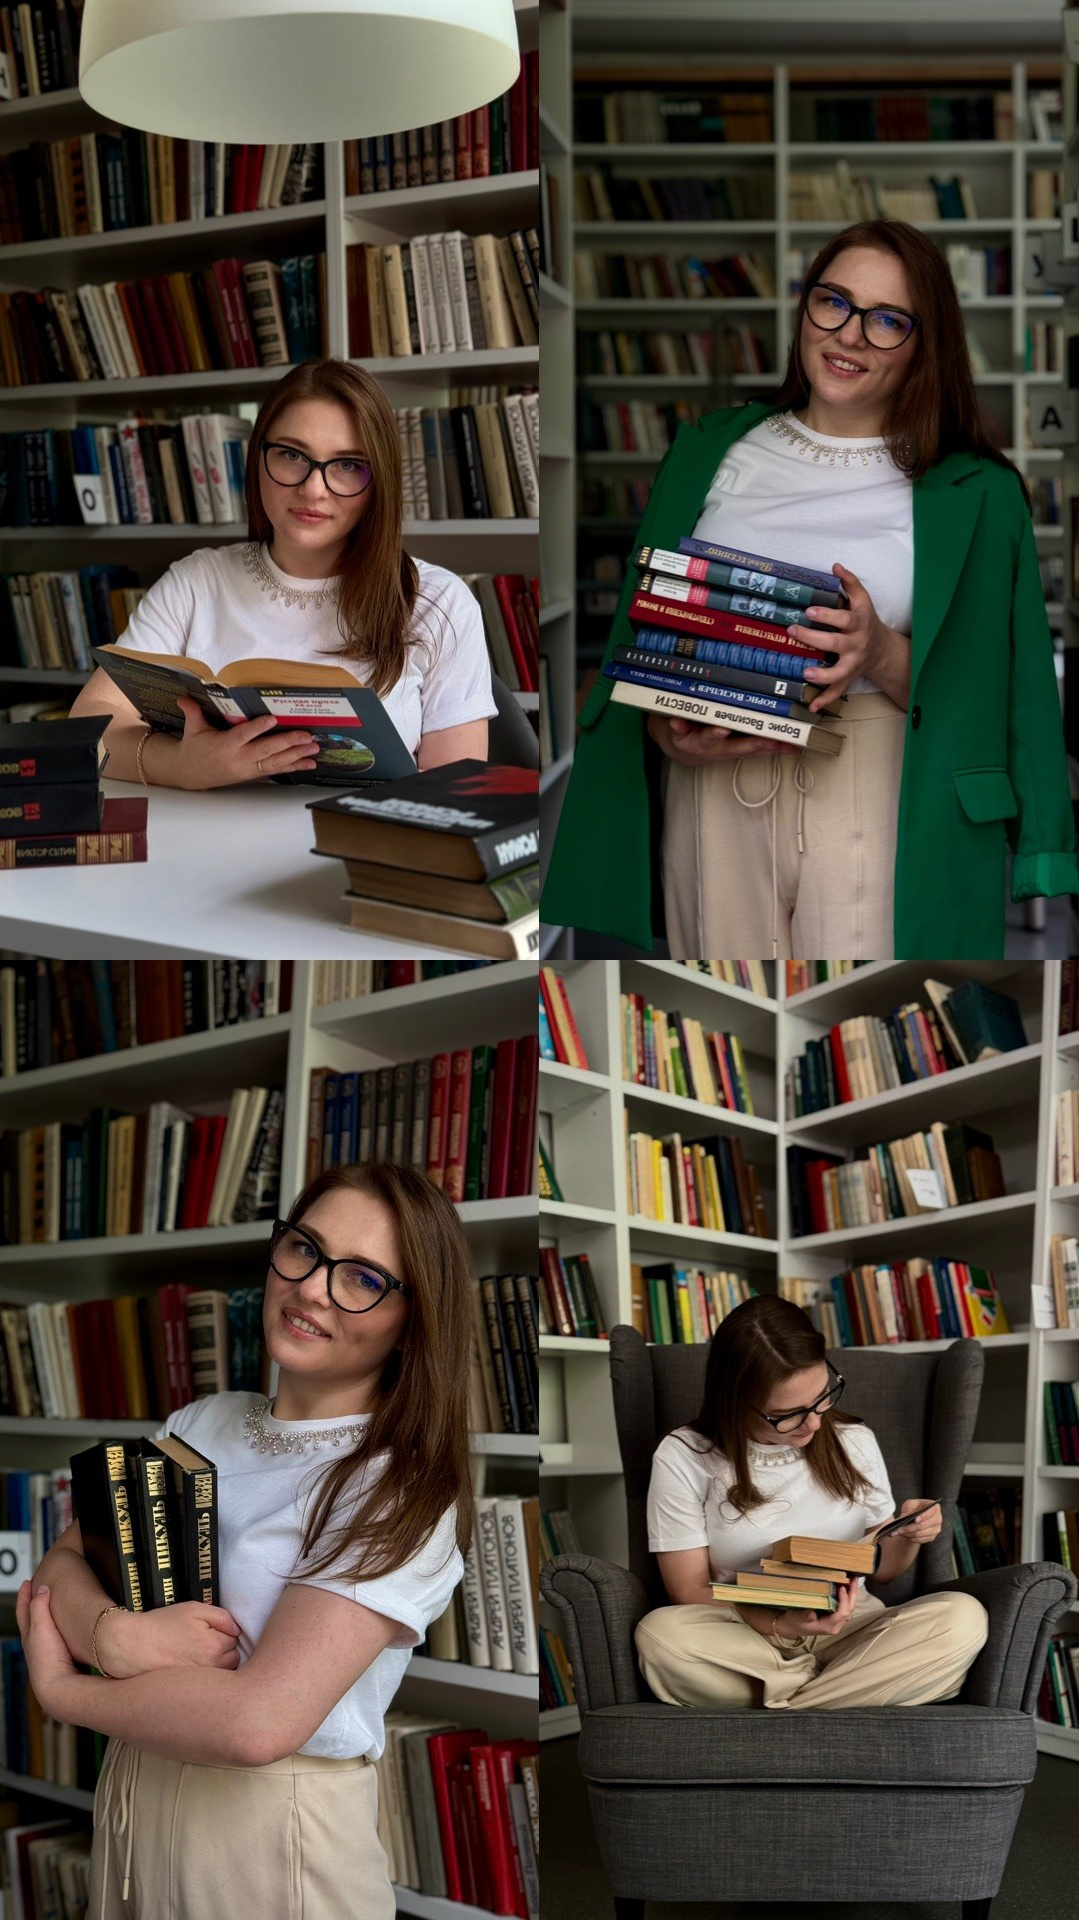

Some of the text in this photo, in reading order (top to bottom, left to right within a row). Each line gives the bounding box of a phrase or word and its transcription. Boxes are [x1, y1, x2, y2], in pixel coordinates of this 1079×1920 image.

[1040, 406, 1062, 431] А
[654, 694, 801, 739] Борис Васильев ПОВЕСТИ
[697, 684, 745, 701] ВАСИЛЬЕВ
[744, 694, 778, 709] БОРИС
[16, 847, 48, 858] ВИКТОР
[114, 1485, 135, 1555] ПИКУЛЬ
[152, 1500, 171, 1571] ПИКУЛЬ
[197, 1512, 213, 1582] ПИКУЛЬ
[480, 1510, 505, 1650] АНДРЕЙ ПЛАТОНОВ
[501, 1514, 527, 1656] АНДРЕЙ ПЛАТОНОВ
[467, 1591, 482, 1647] АНДРЕЙ
